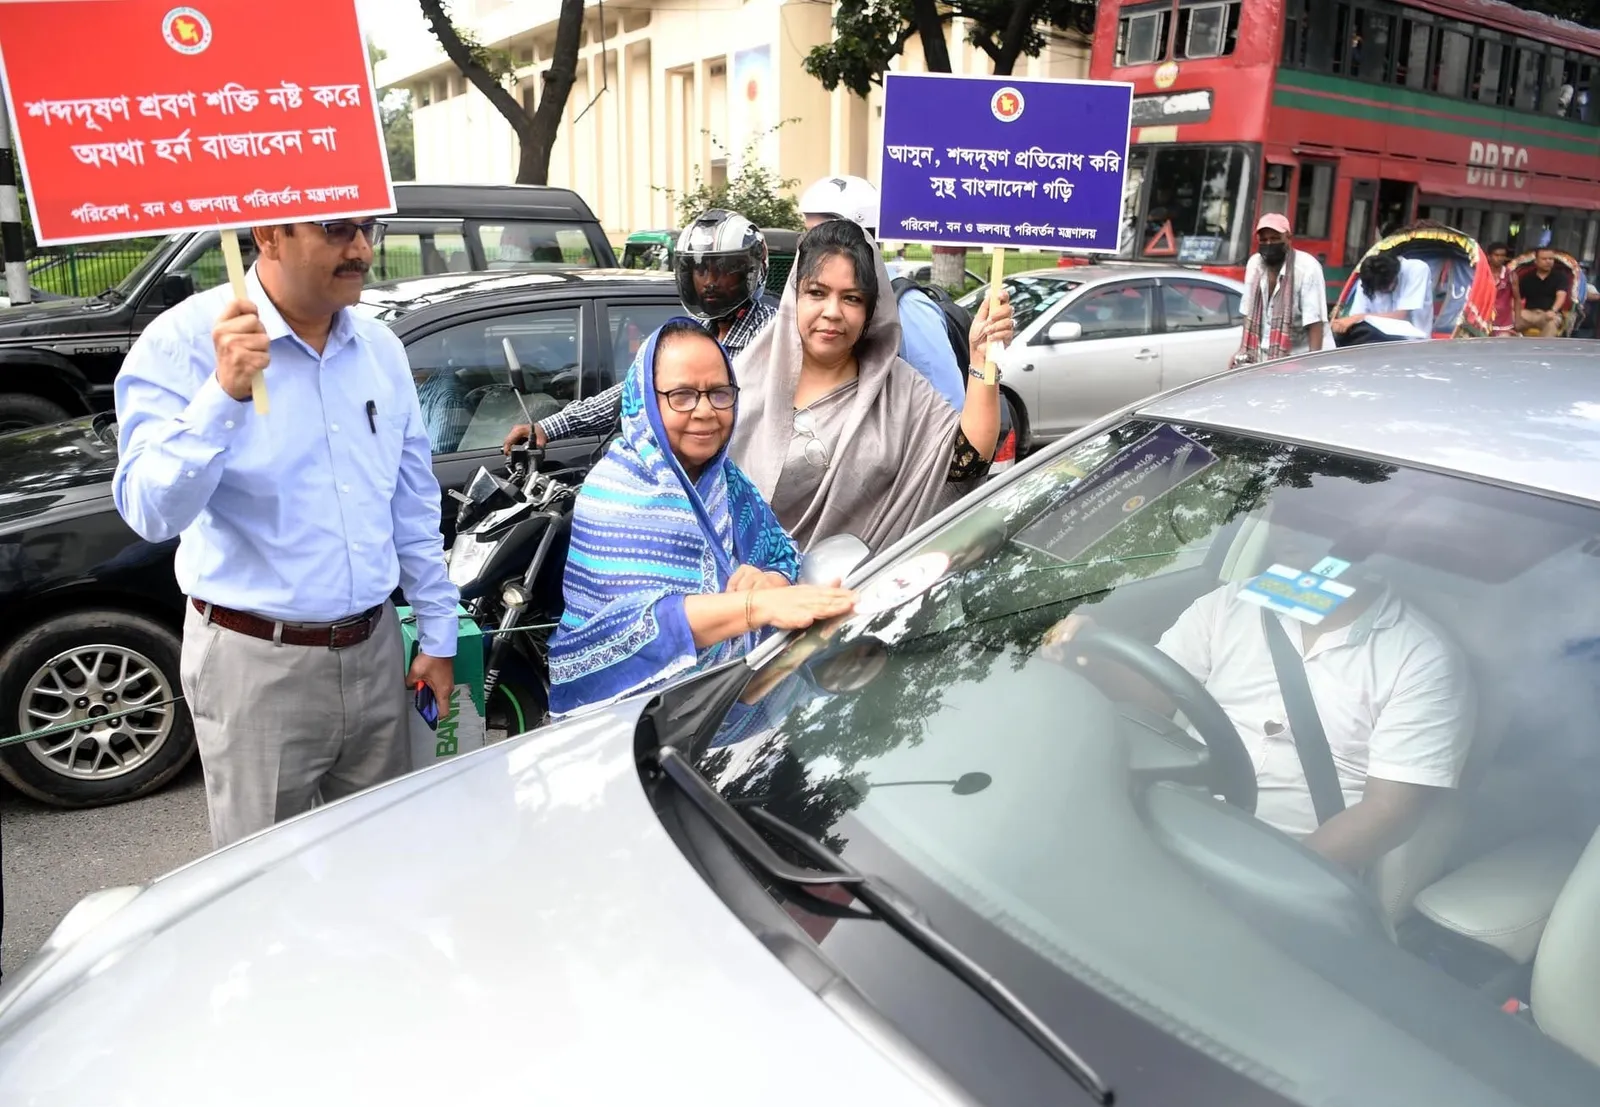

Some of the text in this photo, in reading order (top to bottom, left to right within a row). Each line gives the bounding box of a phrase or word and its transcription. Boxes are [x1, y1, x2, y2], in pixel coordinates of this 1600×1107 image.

[24, 80, 361, 132] শব্দদূষণ শ্রবণ শক্তি নষ্ট করে
[71, 126, 337, 169] অযথা হর্ন বাজাবেন না
[886, 145, 1122, 173] আসুন, শব্দদূষণ প্রতিরোধ করি
[1466, 141, 1528, 189] BRTC
[71, 185, 359, 223] পরিবেশ, বন ও জলবায়ু পরিবর্তন মন্ত্রণালয়
[929, 177, 1075, 203] সুস্থ বাংলাদেশ গড়ি
[901, 216, 1097, 241] পরিবেশ, বন ও জলবায়ু পরিবর্তন মন্ত্রণালয়
[484, 668, 500, 704] MAHA
